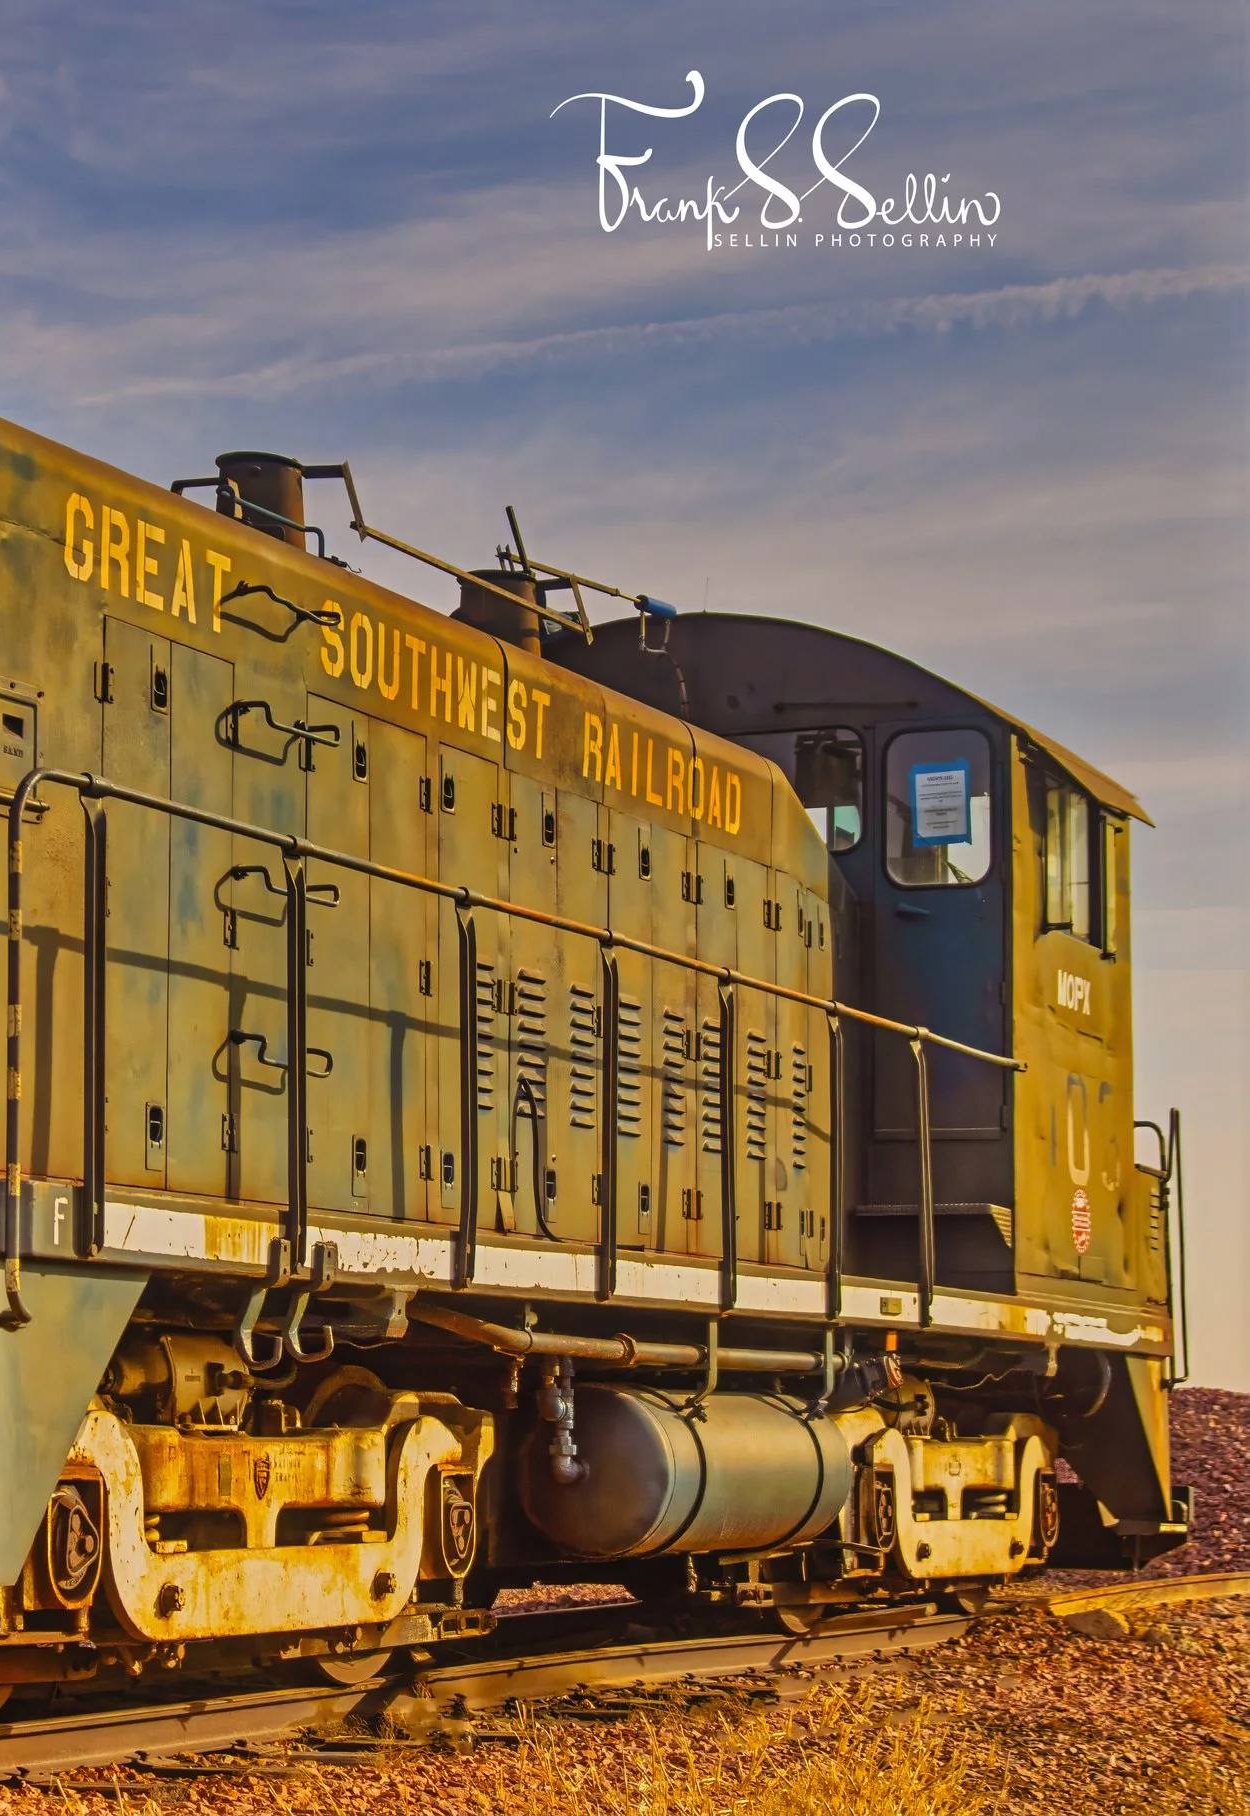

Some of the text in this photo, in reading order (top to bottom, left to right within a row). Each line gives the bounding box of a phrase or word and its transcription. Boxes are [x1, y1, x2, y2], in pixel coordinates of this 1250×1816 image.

[63, 491, 742, 836] GREAT SOUTHWEST RAILROAD
[53, 1197, 69, 1246] F
